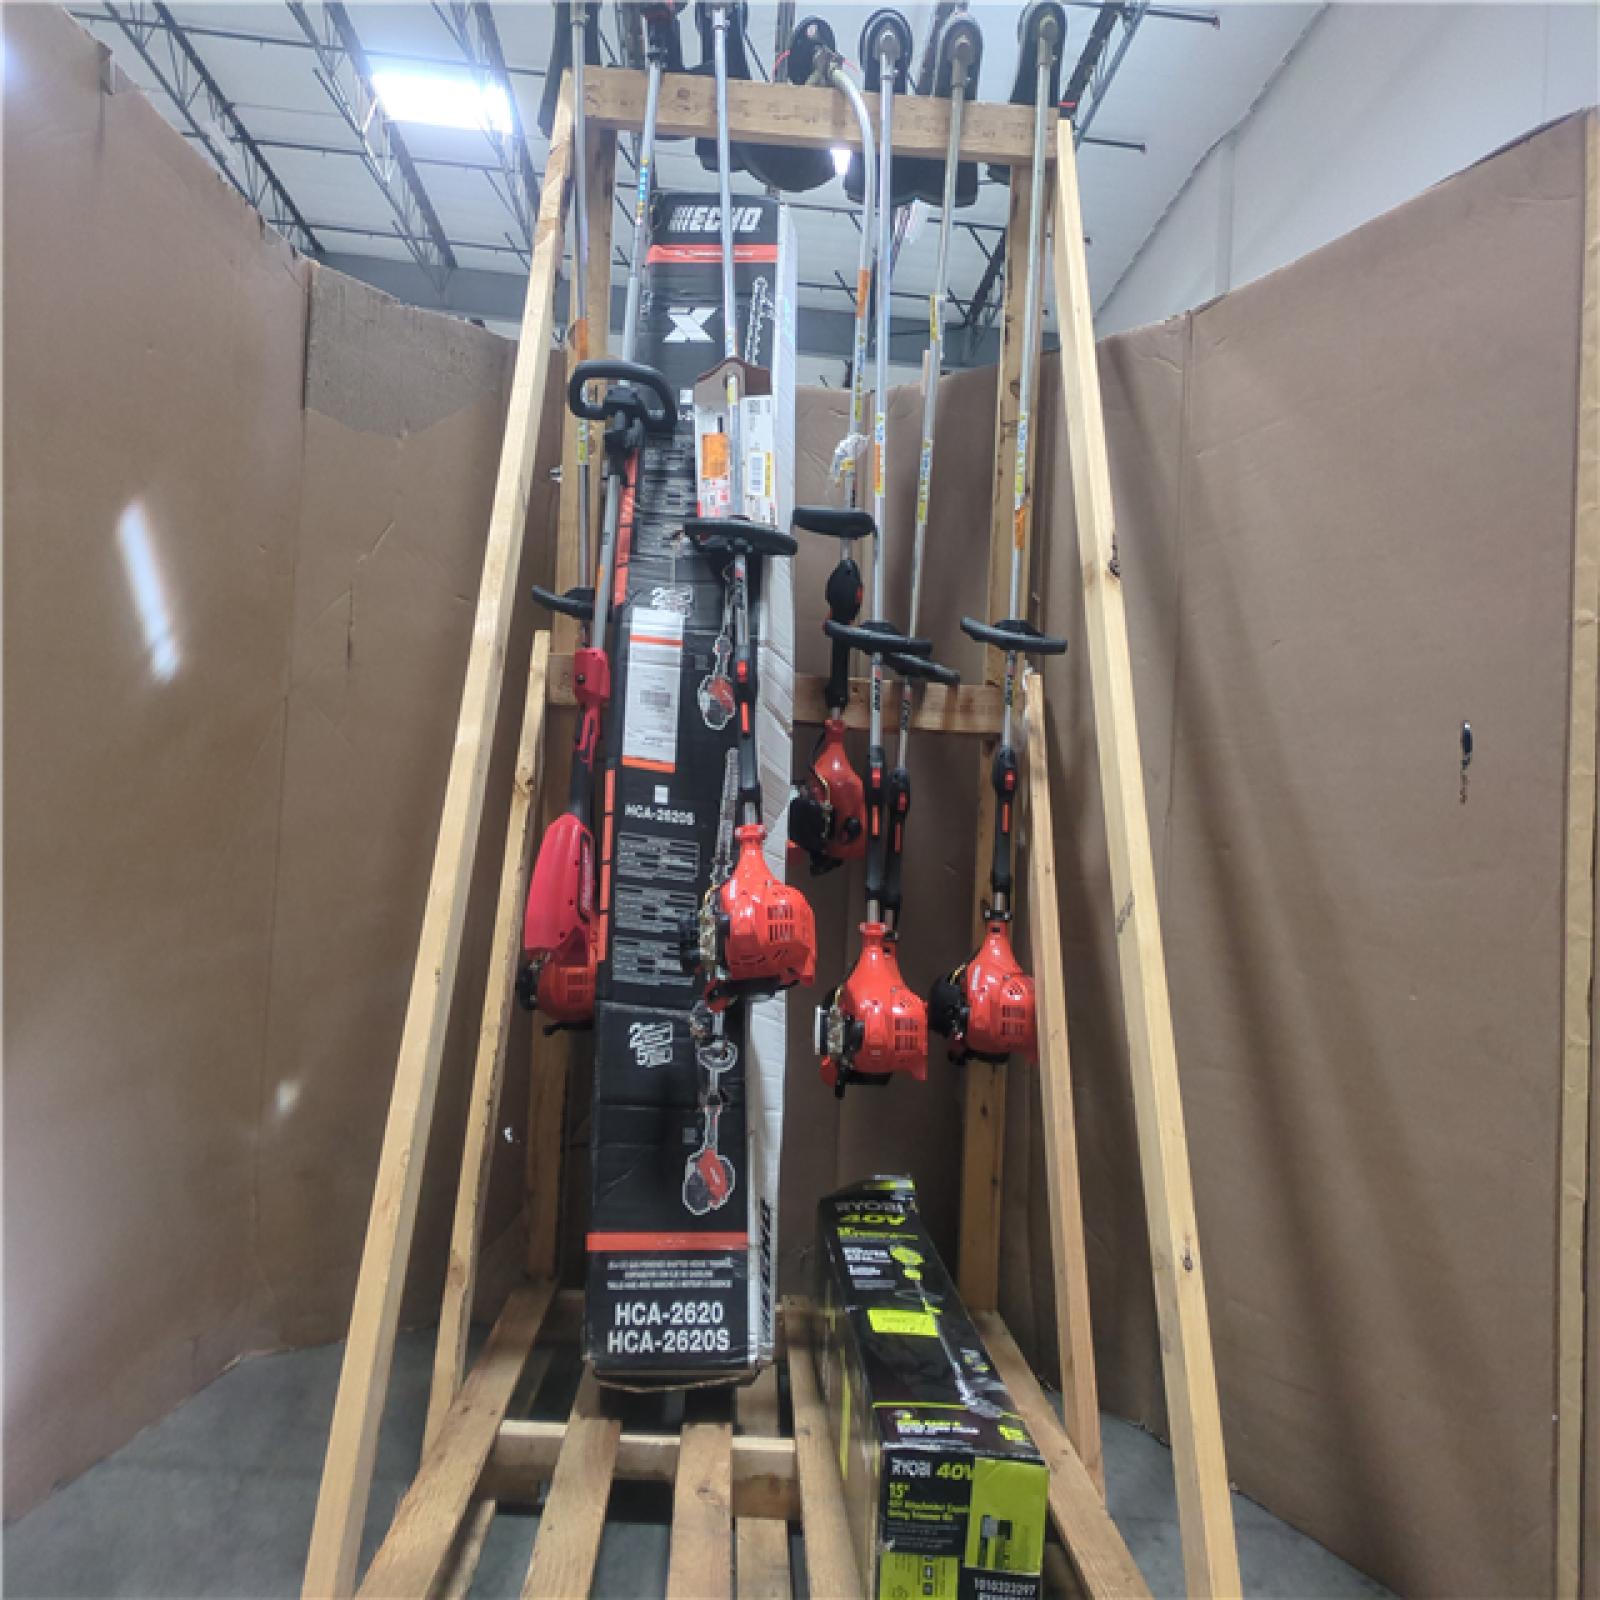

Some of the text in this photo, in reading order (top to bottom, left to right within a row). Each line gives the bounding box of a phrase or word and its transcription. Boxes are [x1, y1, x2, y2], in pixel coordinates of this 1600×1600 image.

[614, 1301, 724, 1326] HCA-2620
[606, 1328, 731, 1354] HCA-2620S
[891, 1457, 931, 1479] RYOBI
